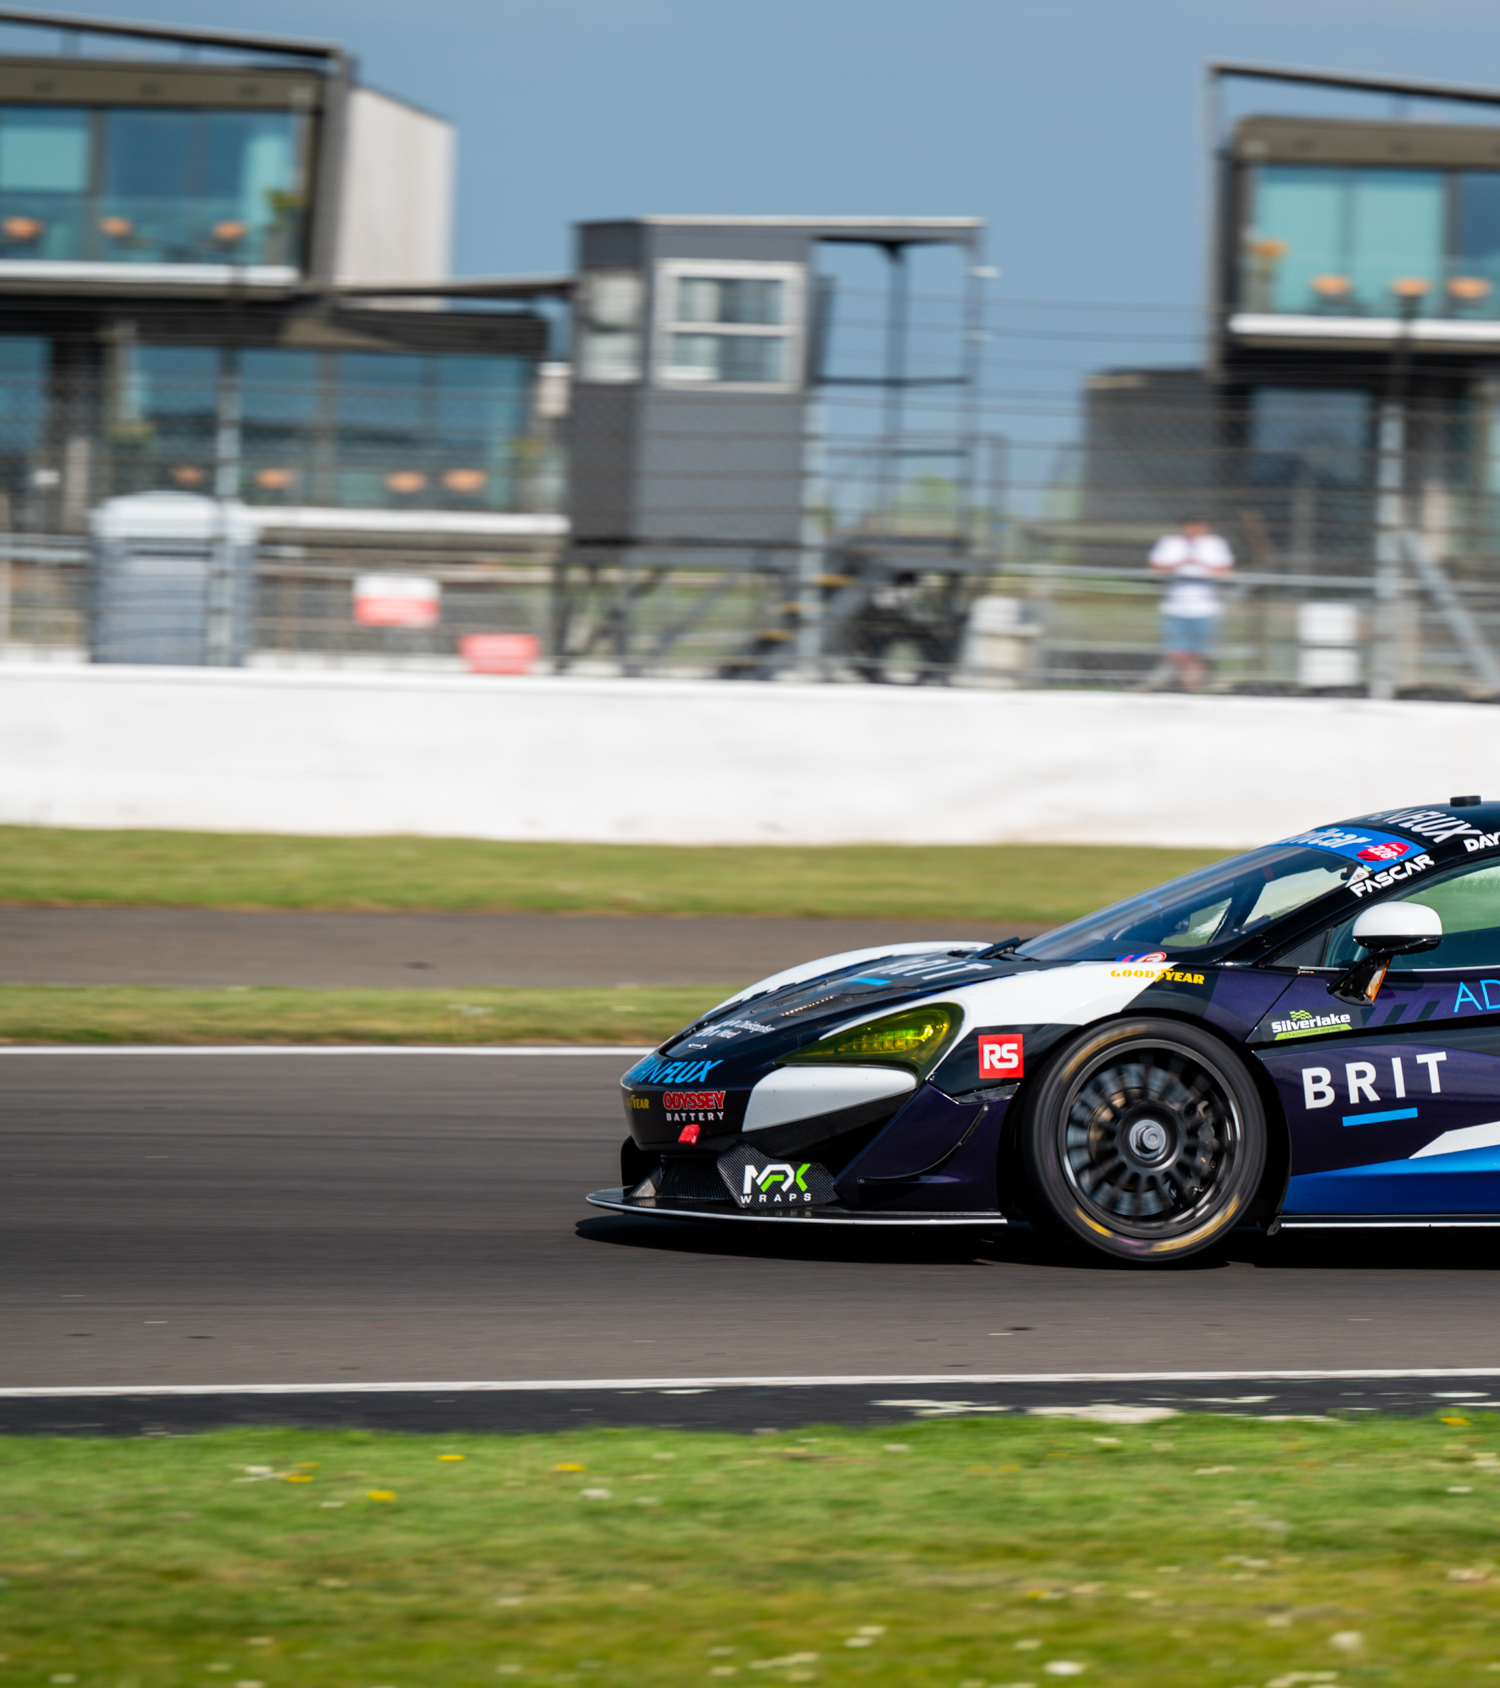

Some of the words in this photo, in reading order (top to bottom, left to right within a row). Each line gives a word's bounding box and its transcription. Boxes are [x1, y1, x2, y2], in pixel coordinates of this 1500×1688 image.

[1350, 853, 1434, 898] FASCAR
[1271, 1013, 1351, 1033] Silverlake
[983, 1043, 1019, 1069] RS
[1302, 1051, 1447, 1110] BRIT
[663, 1091, 726, 1110] ODYSSEY
[666, 1112, 724, 1121] BATTERY
[740, 1192, 812, 1204] WRAPS
